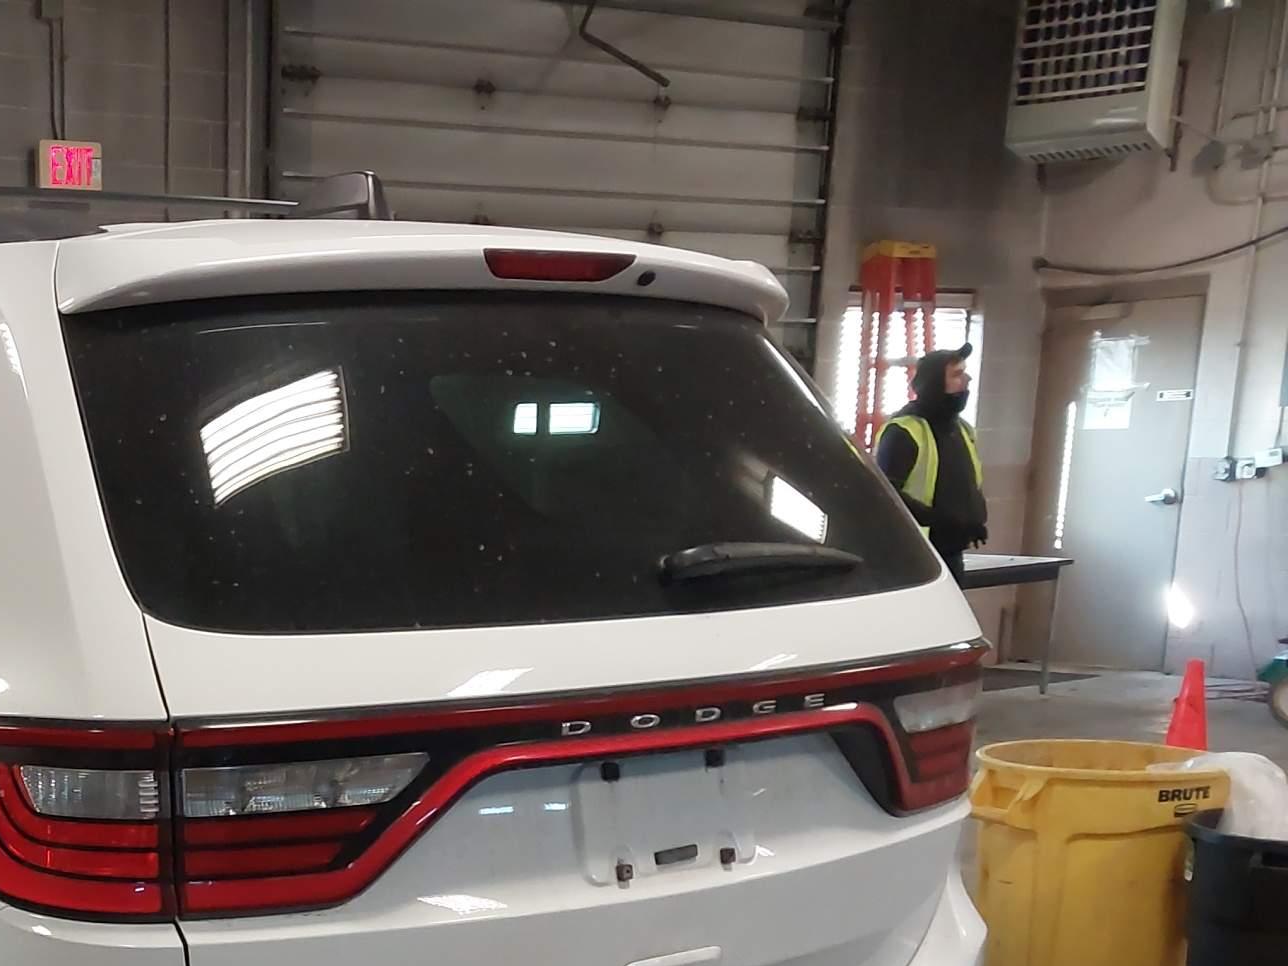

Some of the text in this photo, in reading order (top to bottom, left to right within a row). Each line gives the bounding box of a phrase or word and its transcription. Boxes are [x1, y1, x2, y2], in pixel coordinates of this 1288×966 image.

[50, 146, 94, 186] EXIT
[561, 693, 825, 736] DODGE
[1157, 785, 1211, 803] BRUTE
